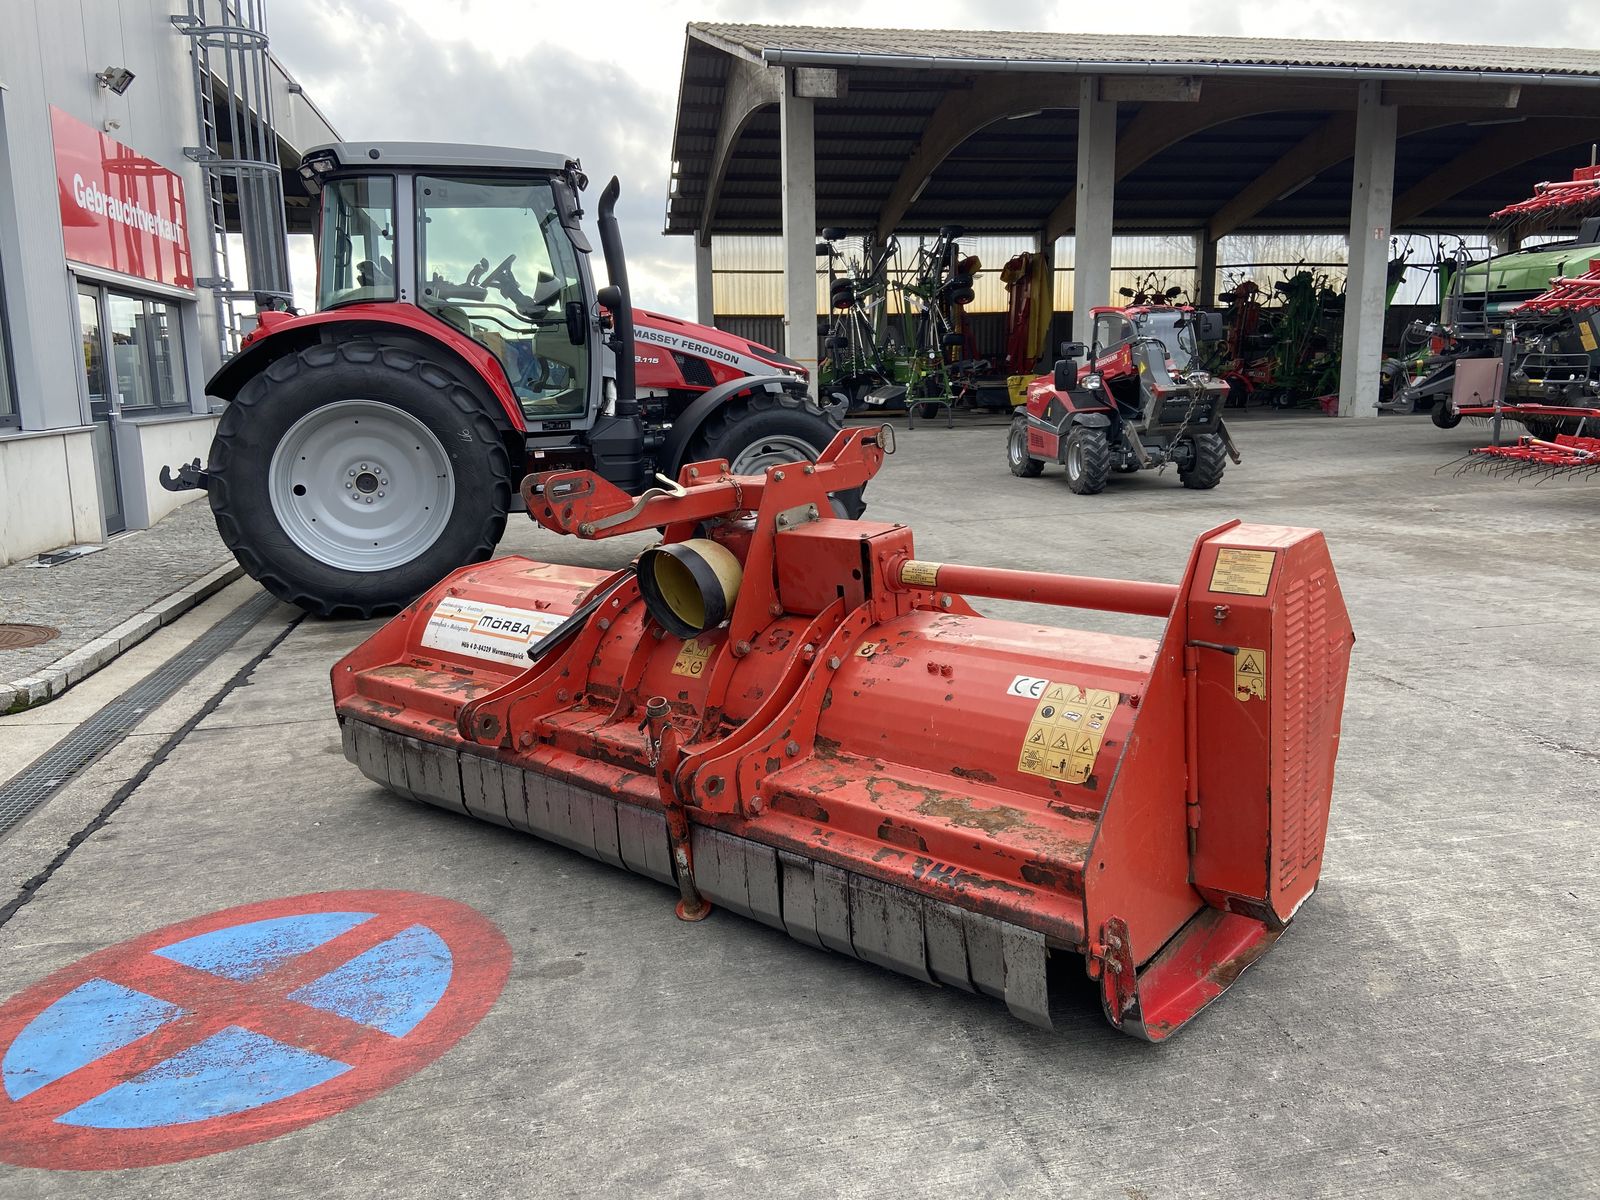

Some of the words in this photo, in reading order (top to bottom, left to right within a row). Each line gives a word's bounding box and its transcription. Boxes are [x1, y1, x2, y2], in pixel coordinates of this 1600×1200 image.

[73, 173, 181, 244] Gebrauchtverkauf
[633, 328, 679, 346] MASSEY
[681, 340, 740, 365] FERGUSON
[478, 615, 532, 635] MÖRBA
[1014, 678, 1046, 697] CE
